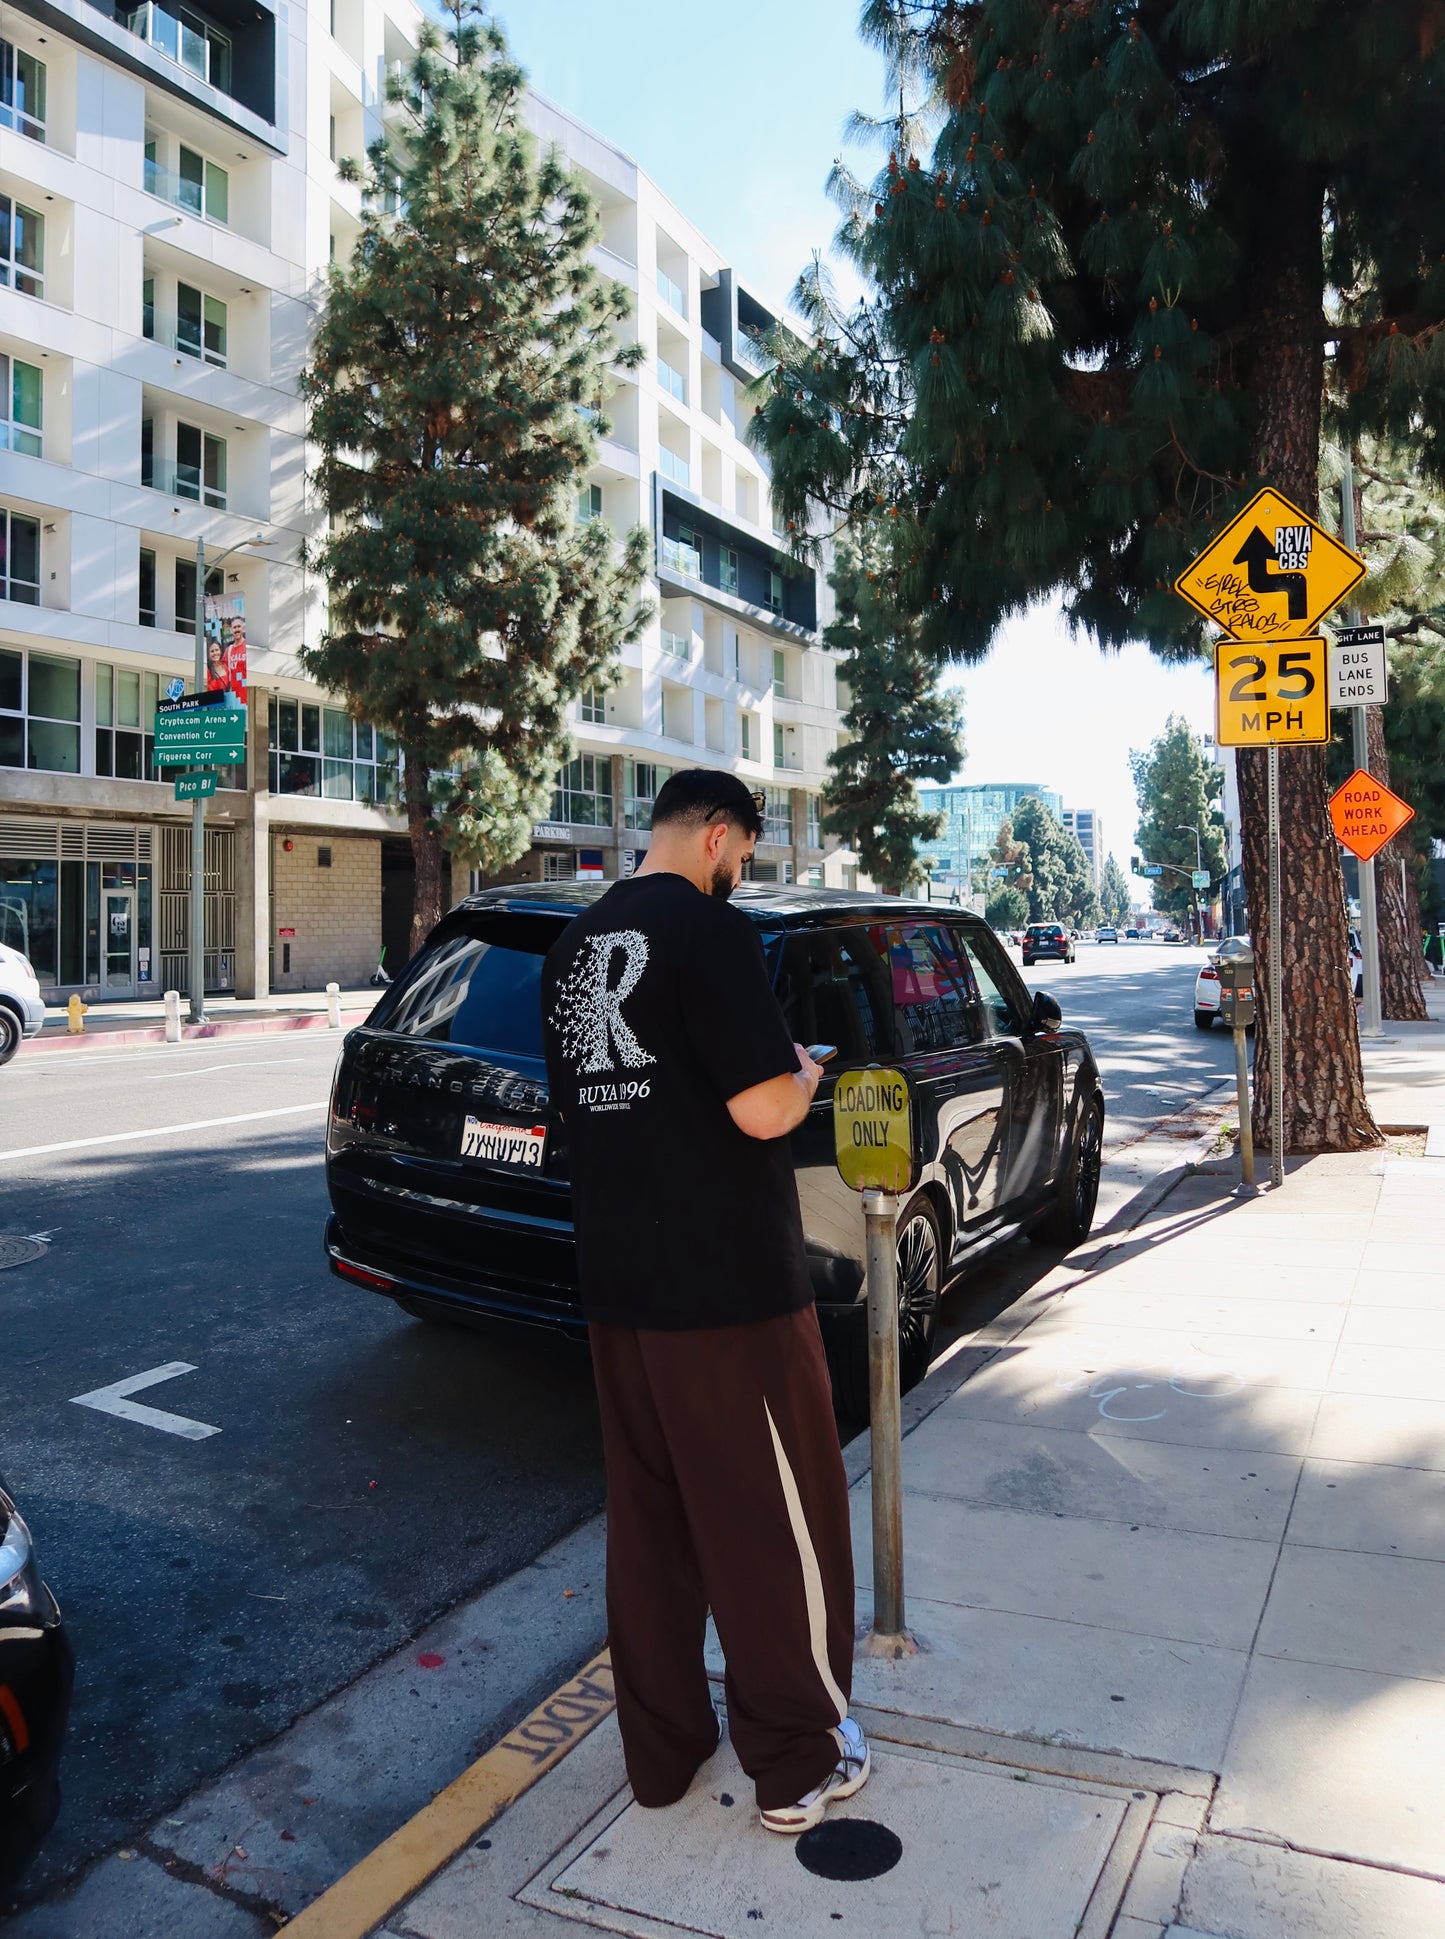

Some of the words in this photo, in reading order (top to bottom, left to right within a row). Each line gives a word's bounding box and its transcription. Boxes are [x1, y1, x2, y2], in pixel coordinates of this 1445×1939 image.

[1278, 552, 1308, 570] CBS
[1357, 631, 1380, 641] LANE
[1342, 652, 1368, 665] BUS
[1229, 652, 1315, 702] 25
[1338, 668, 1373, 681] LANE
[1339, 684, 1374, 697] ENDS
[159, 703, 181, 713] SOUTH
[182, 700, 200, 708] PARK
[159, 717, 200, 727] Crypto.com
[204, 715, 227, 724] Arena
[1241, 710, 1303, 732] MPH
[159, 732, 200, 741] Convention
[203, 731, 216, 739] Ctr
[158, 752, 191, 762] Figueroa
[195, 751, 212, 759] Corr
[179, 782, 197, 792] Pico
[1344, 791, 1380, 803] ROAD
[1344, 807, 1382, 820] WORK
[534, 826, 570, 840] PARKING
[1342, 824, 1388, 837] AHEAD
[389, 1067, 484, 1096] RANGE
[578, 1083, 618, 1105] RUYA
[838, 1084, 903, 1113] LOADING
[852, 1120, 889, 1147] ONLY
